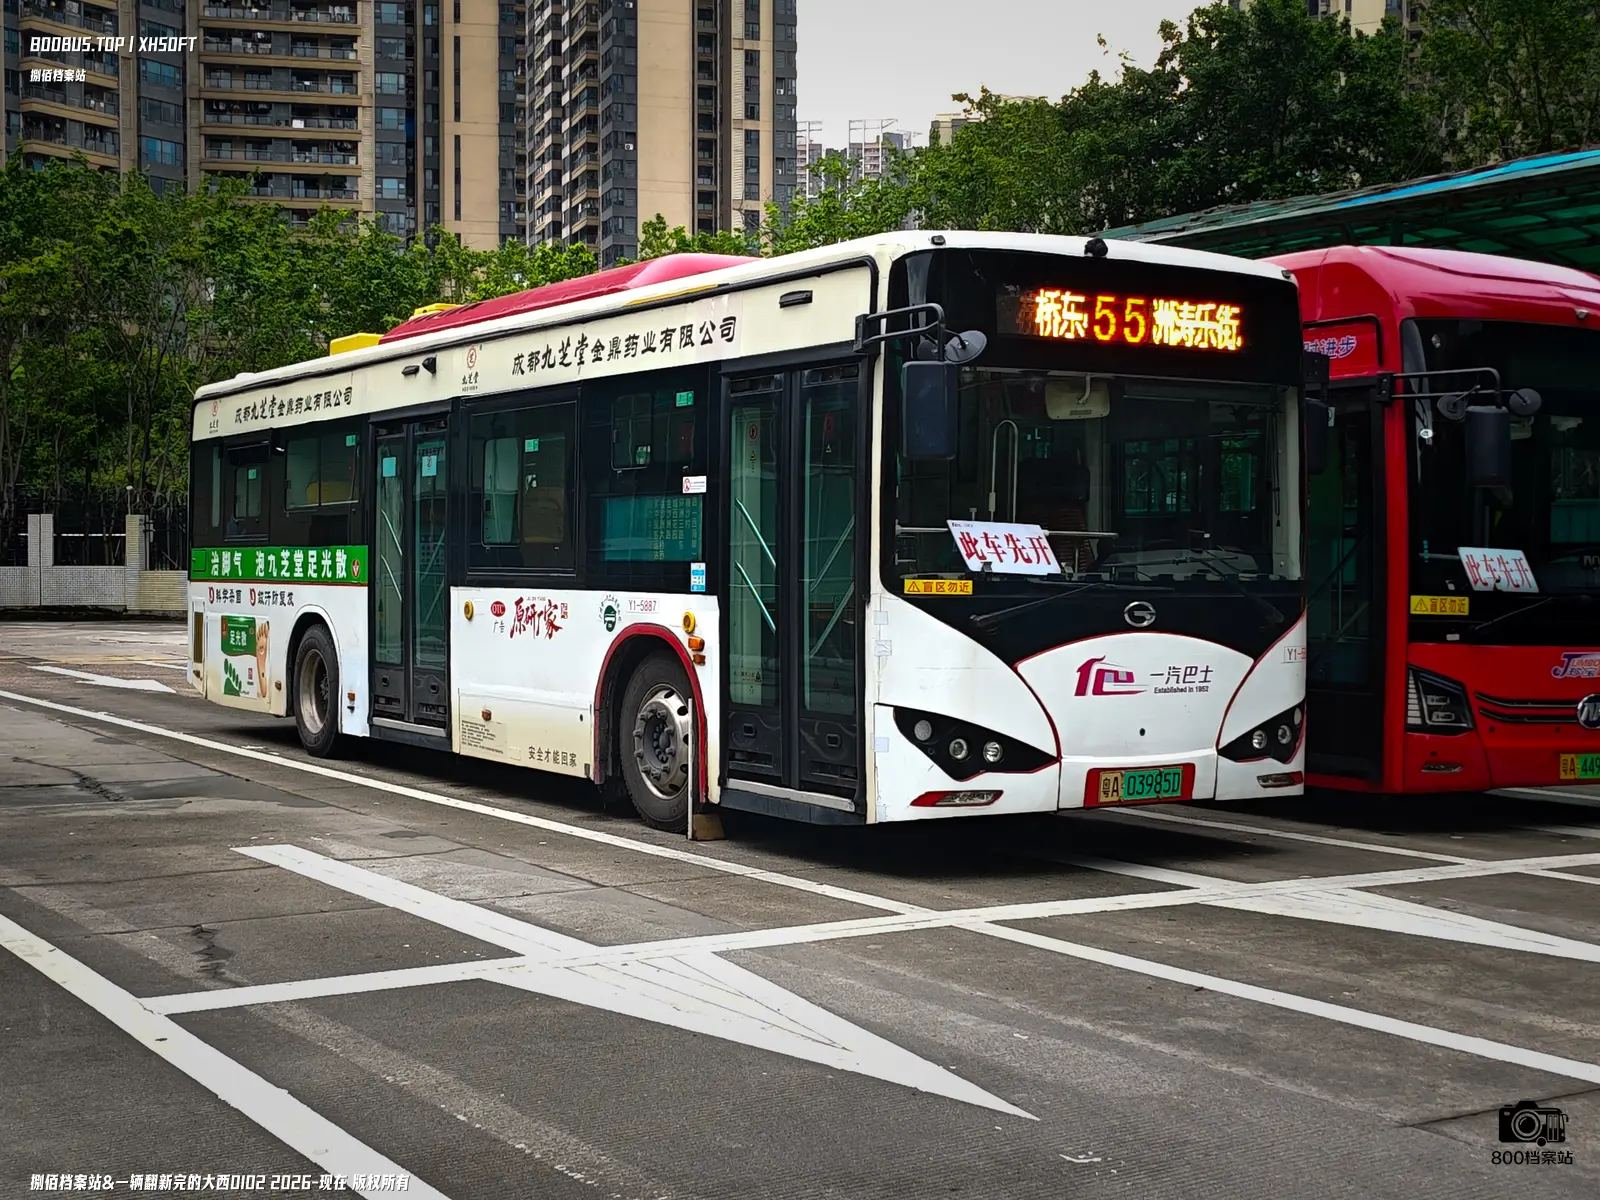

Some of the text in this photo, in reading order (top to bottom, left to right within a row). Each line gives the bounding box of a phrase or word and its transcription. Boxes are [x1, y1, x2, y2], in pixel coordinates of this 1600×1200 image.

[1093, 295, 1146, 344] 55
[511, 316, 737, 376] 成都九芝堂金鼎药业有限公司
[959, 531, 1051, 565] 此车先开
[211, 549, 348, 579] 治脚气 泡九芝堂足光散
[1465, 554, 1533, 589] 此车先开
[923, 581, 971, 594] 盲区勿近
[628, 599, 657, 612] Y1-5887
[1429, 598, 1467, 614] 盲区勿近
[1150, 665, 1214, 684] 一汽巴士
[1154, 686, 1187, 694] Established
[528, 746, 577, 768] 安全才能回家
